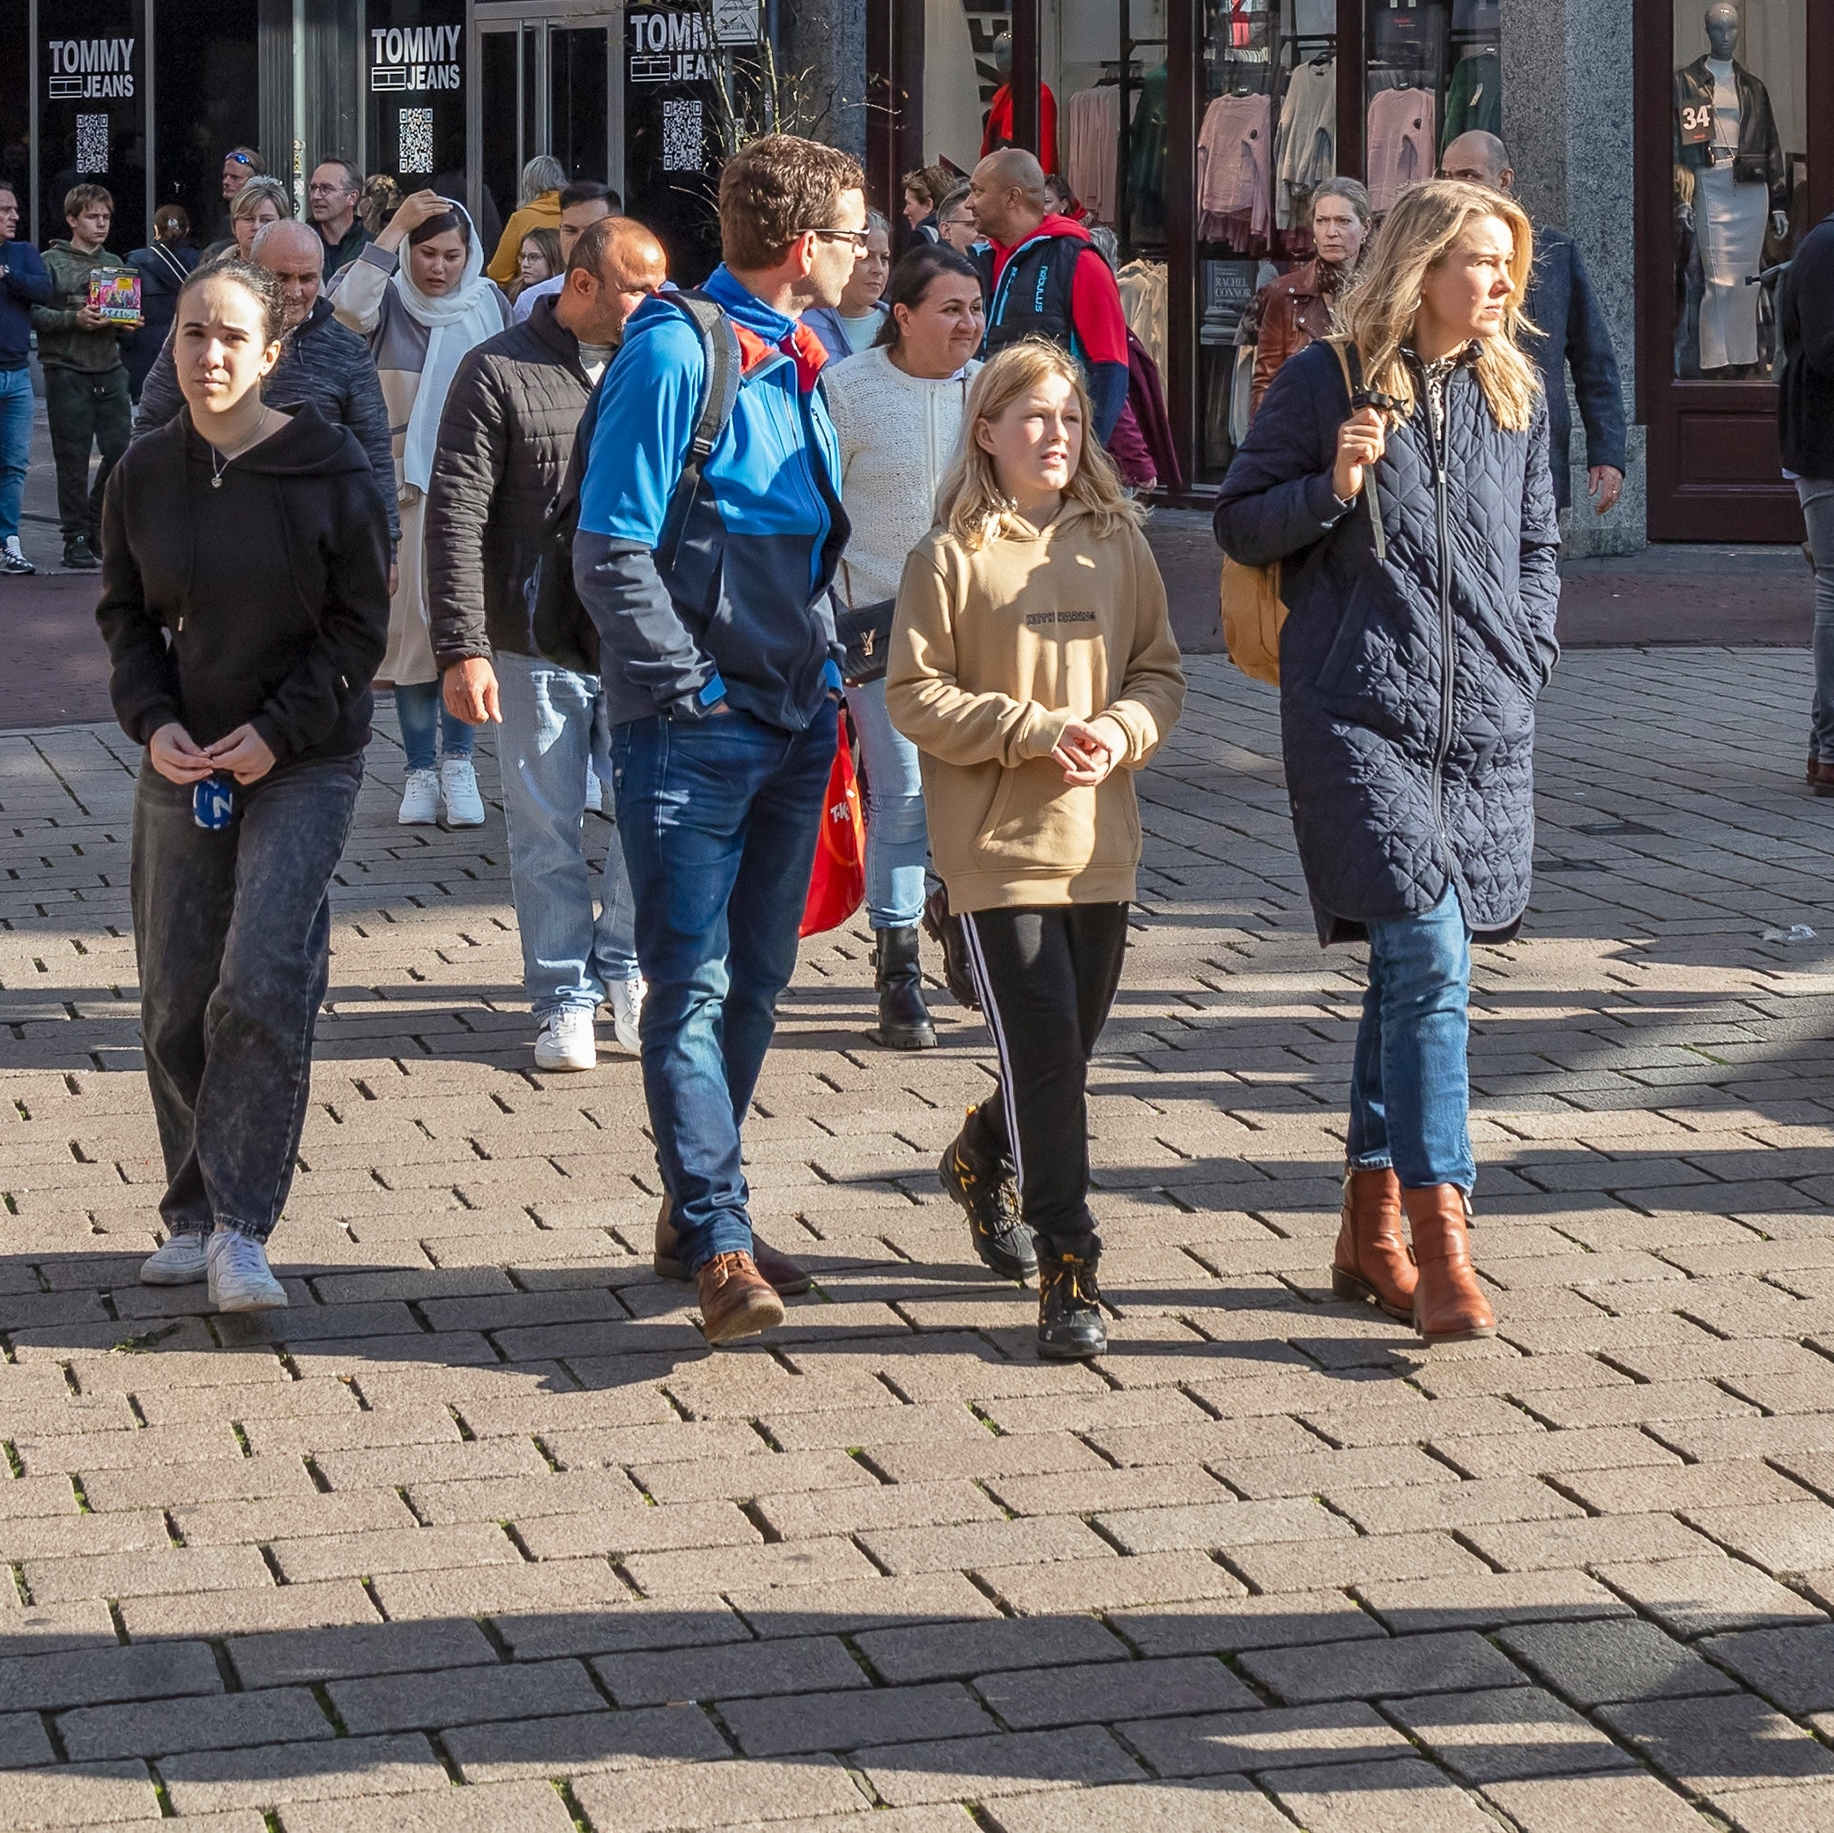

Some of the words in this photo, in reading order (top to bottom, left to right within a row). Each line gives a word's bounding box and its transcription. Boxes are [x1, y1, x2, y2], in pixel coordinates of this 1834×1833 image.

[49, 38, 135, 74] TOMMY
[371, 24, 462, 64] TOMMY
[83, 74, 134, 98] JEANS
[405, 64, 461, 92] JEANS
[1682, 105, 1710, 130] 34
[1035, 265, 1048, 313] nebulus
[1215, 287, 1251, 298] CONNOR
[1216, 277, 1249, 287] RACHEL
